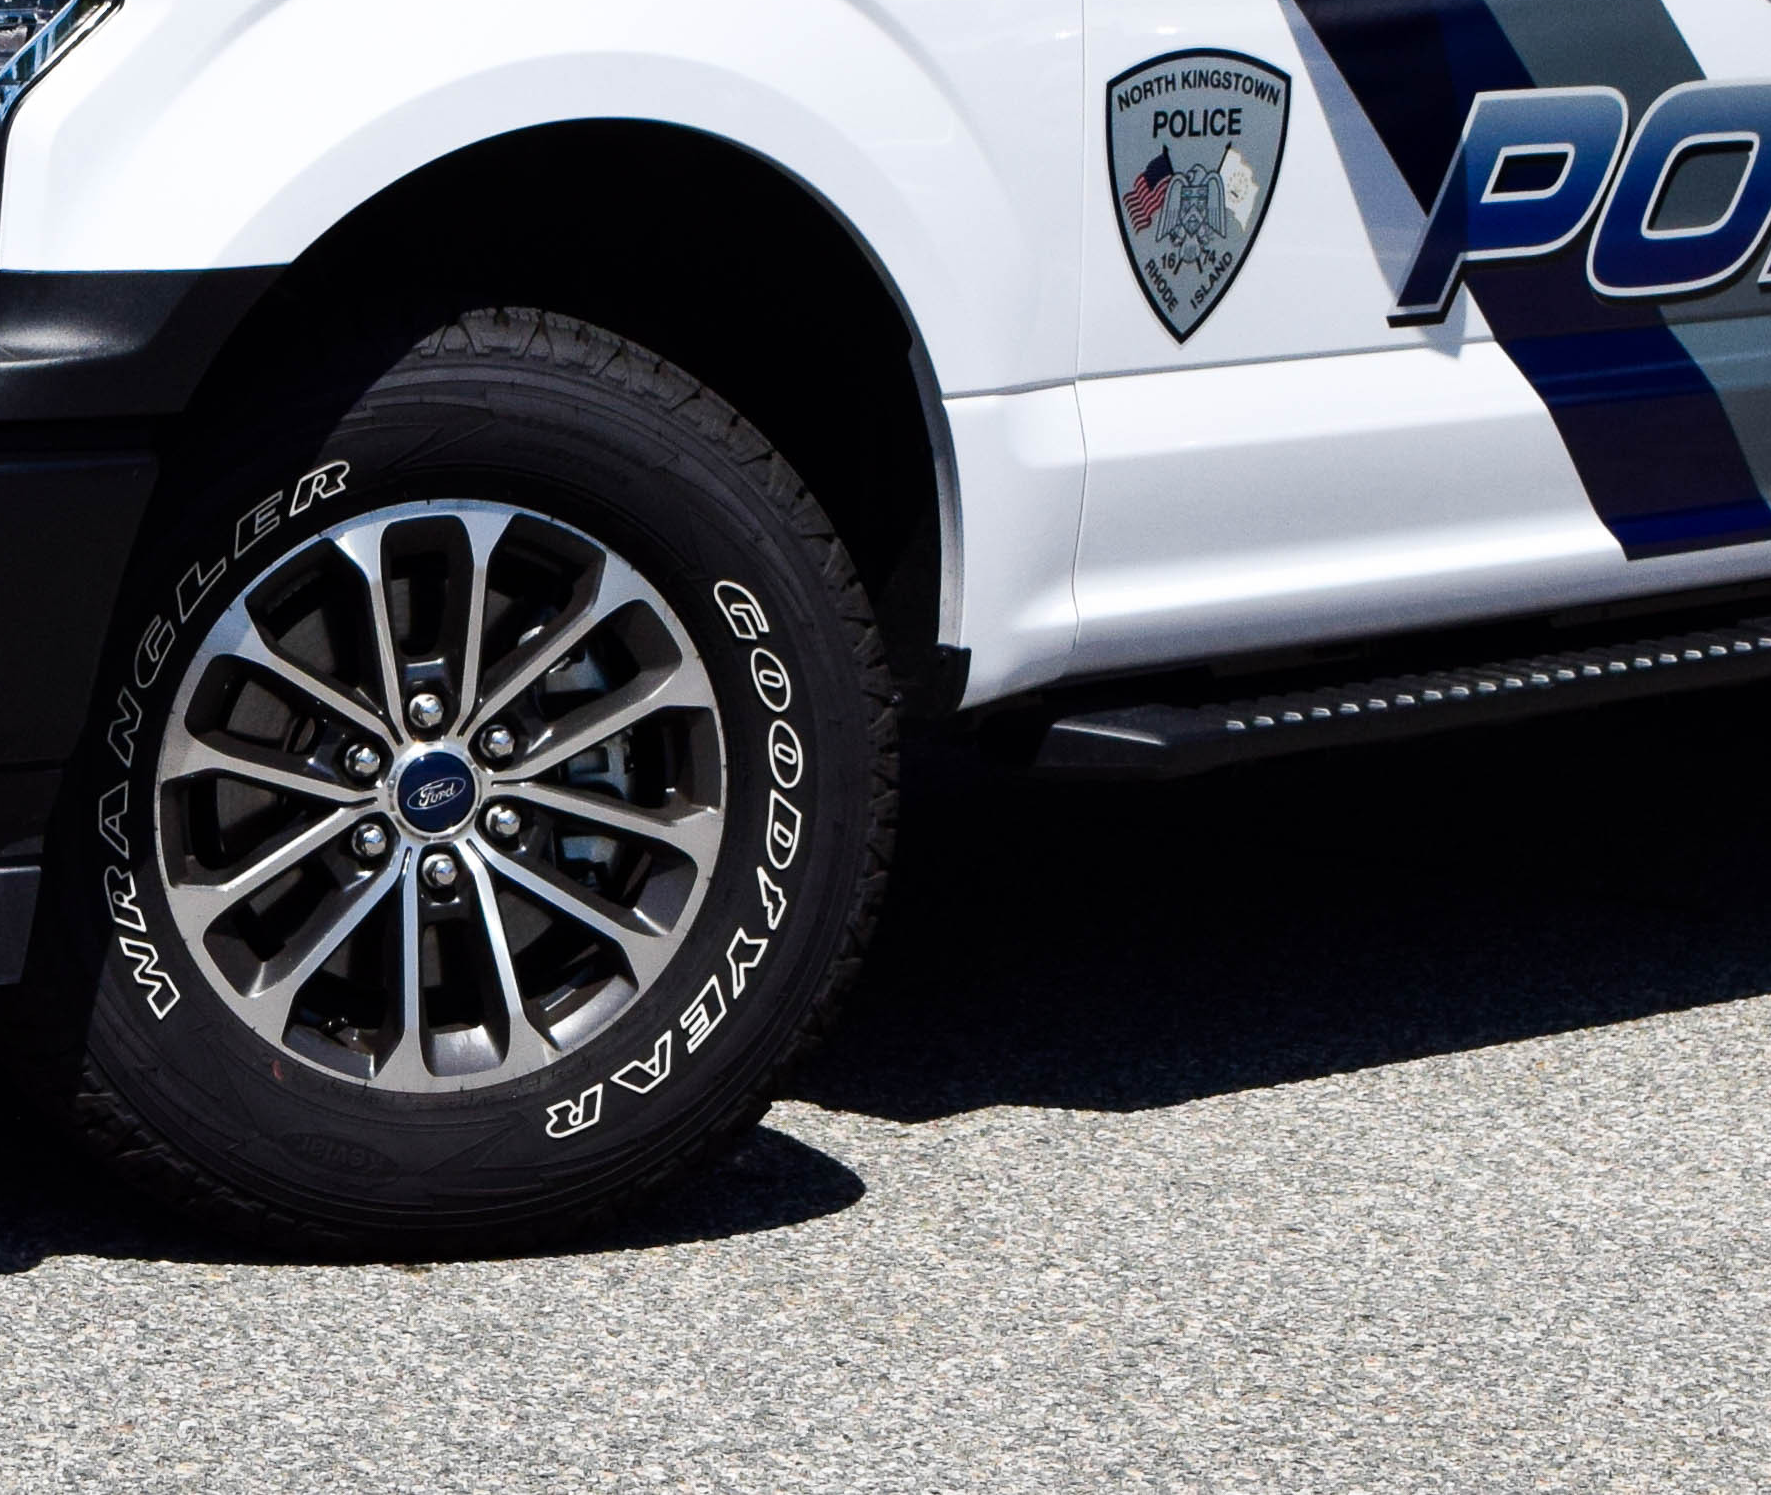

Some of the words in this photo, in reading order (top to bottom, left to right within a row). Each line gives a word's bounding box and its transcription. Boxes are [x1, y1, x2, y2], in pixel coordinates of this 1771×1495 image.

[1117, 72, 1177, 112] NORTH
[1181, 69, 1281, 107] KINGSTOWN
[1152, 108, 1243, 139] POLICE
[1144, 258, 1179, 313] RHODE
[1190, 251, 1233, 309] ISLAND
[98, 460, 351, 1020] WRANGLER
[418, 781, 456, 807] Ford
